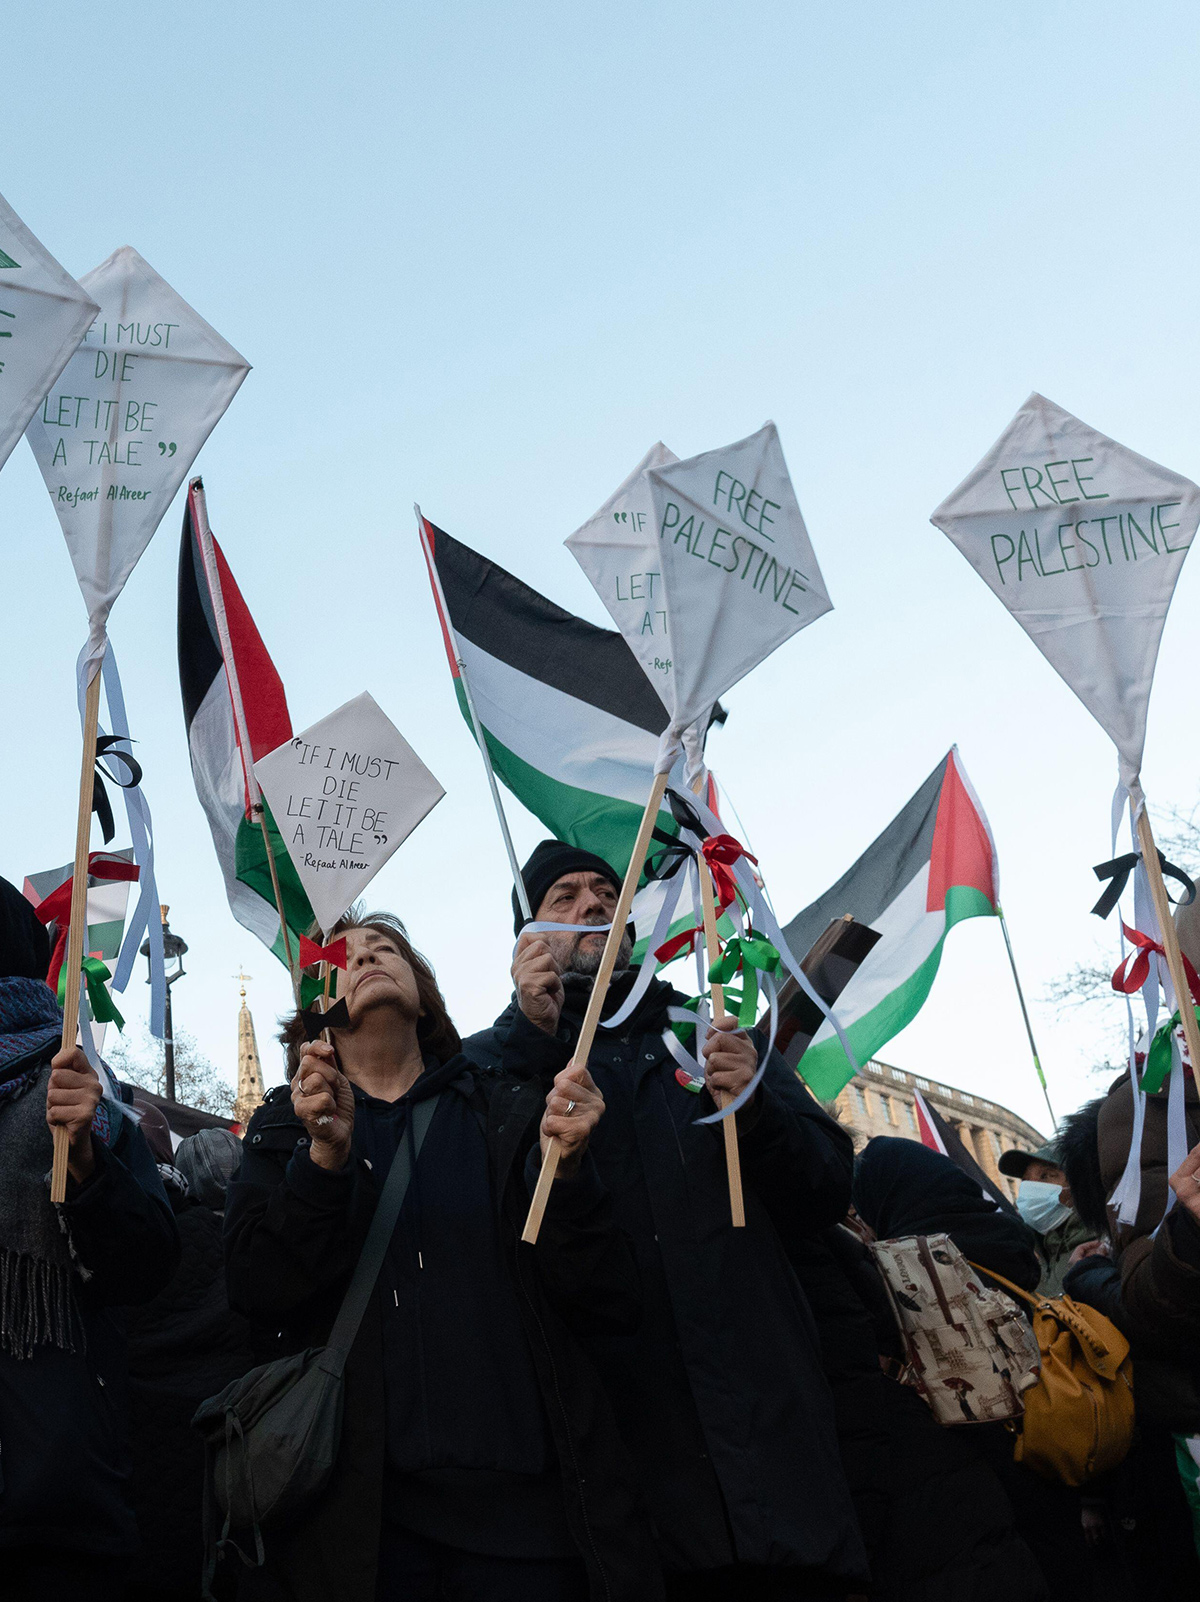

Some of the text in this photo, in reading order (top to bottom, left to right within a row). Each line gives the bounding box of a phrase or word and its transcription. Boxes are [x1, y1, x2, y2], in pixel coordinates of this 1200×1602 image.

[117, 322, 180, 349] MUST
[95, 350, 139, 382] DIE
[43, 395, 158, 432] LET IT BE
[52, 438, 67, 466] A
[1000, 457, 1110, 511] FREE
[713, 470, 782, 543] FREE
[660, 502, 810, 615] PALESTINE
[990, 502, 1190, 585] PALESTINE
[616, 572, 661, 601] LET
[641, 611, 654, 635] A
[323, 747, 337, 769] I
[340, 751, 400, 781] MUST
[322, 775, 360, 802] DIE
[286, 795, 388, 832] LET IT BE
[292, 823, 305, 845] A
